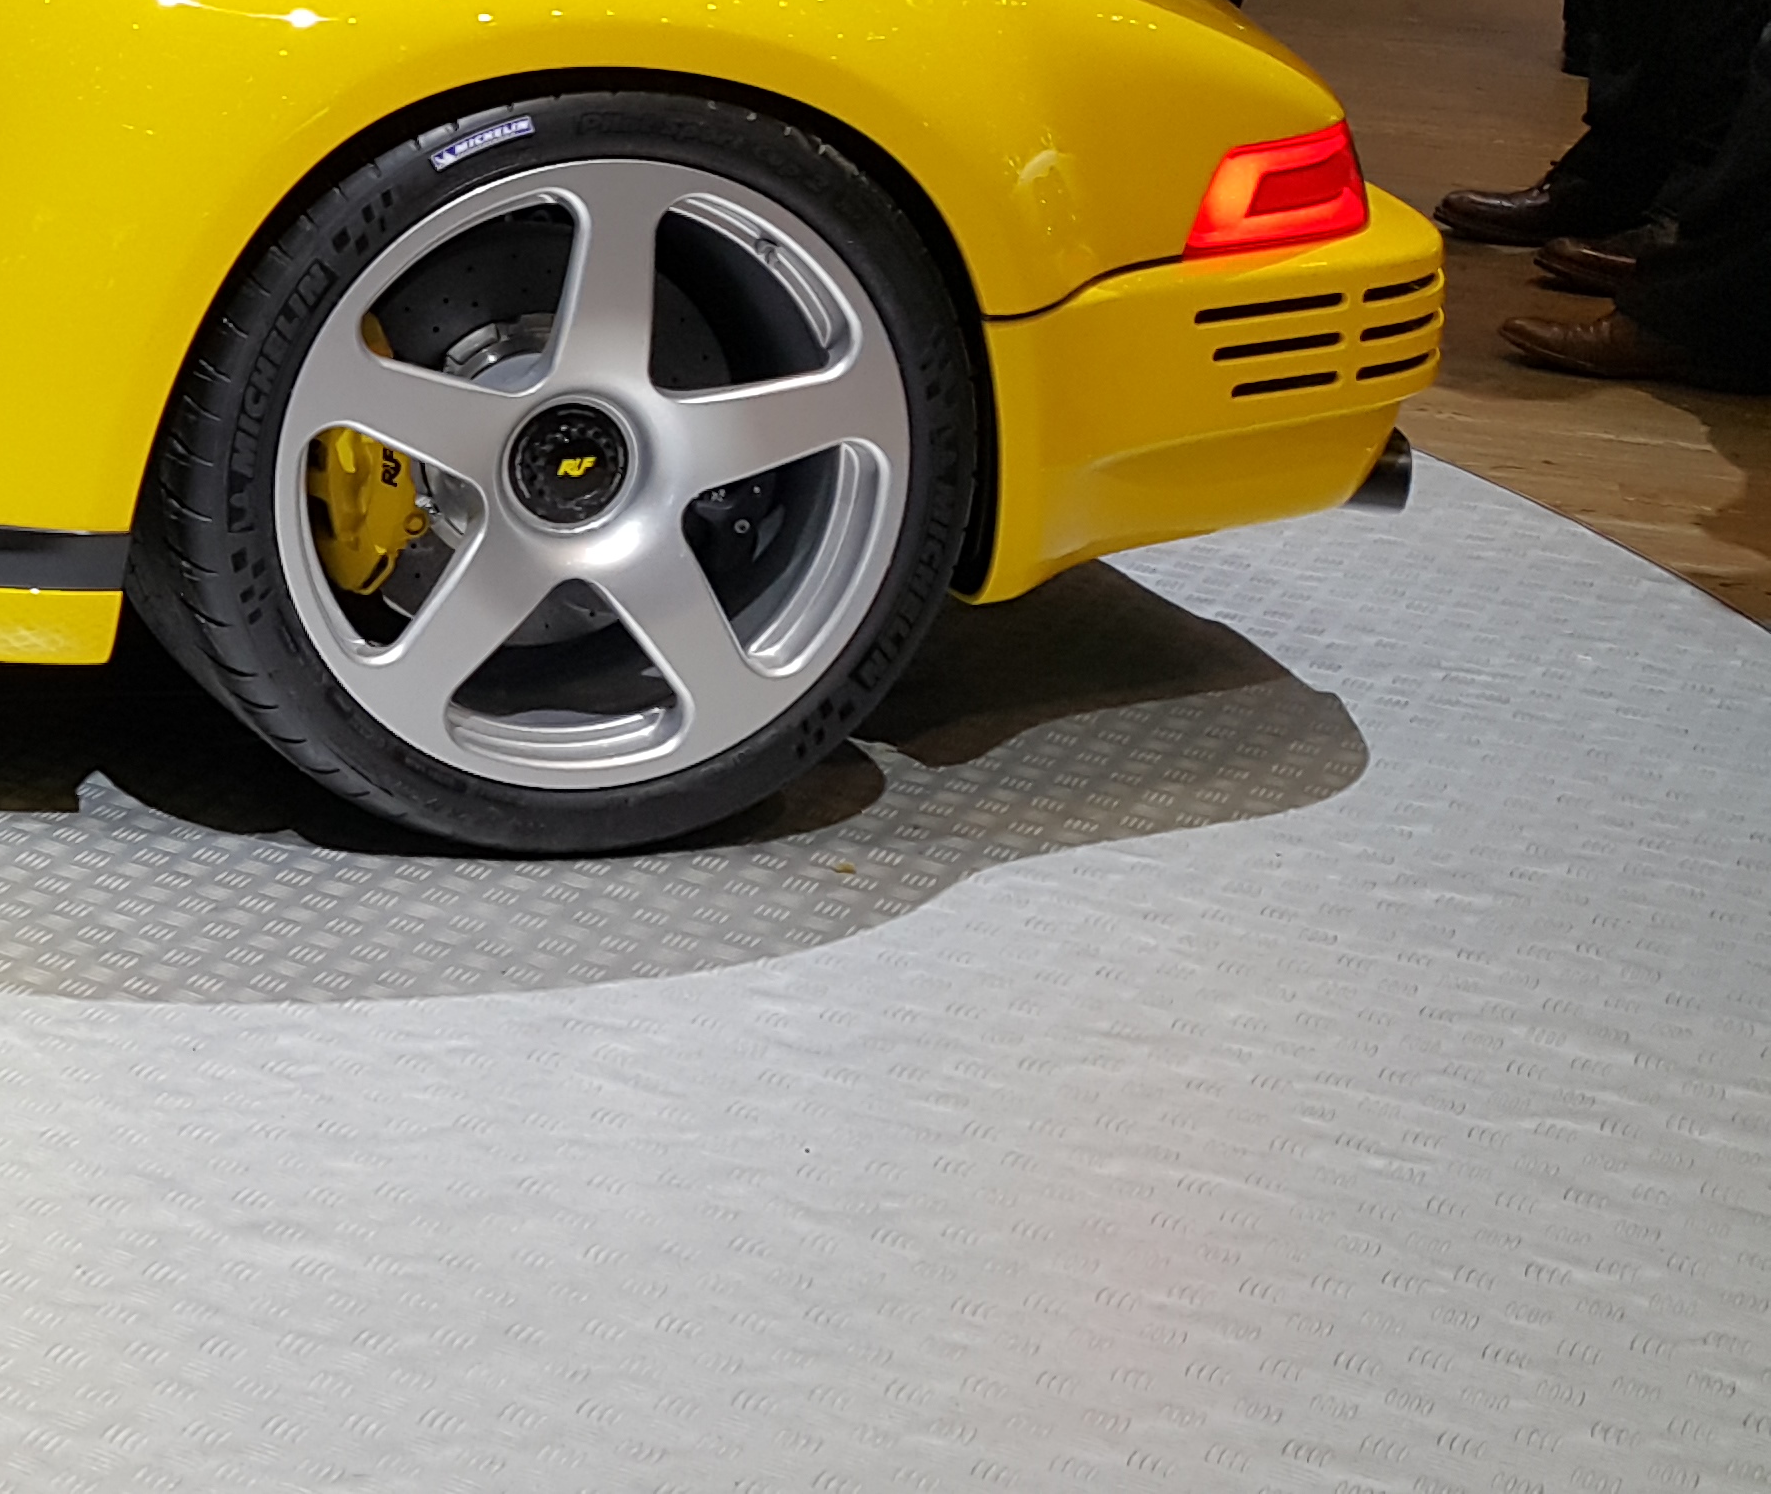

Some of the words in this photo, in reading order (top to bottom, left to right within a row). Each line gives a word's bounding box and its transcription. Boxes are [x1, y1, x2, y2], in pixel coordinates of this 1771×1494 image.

[454, 119, 530, 155] MICHELIN
[231, 261, 330, 480] MICHELIN
[556, 456, 597, 477] RUF
